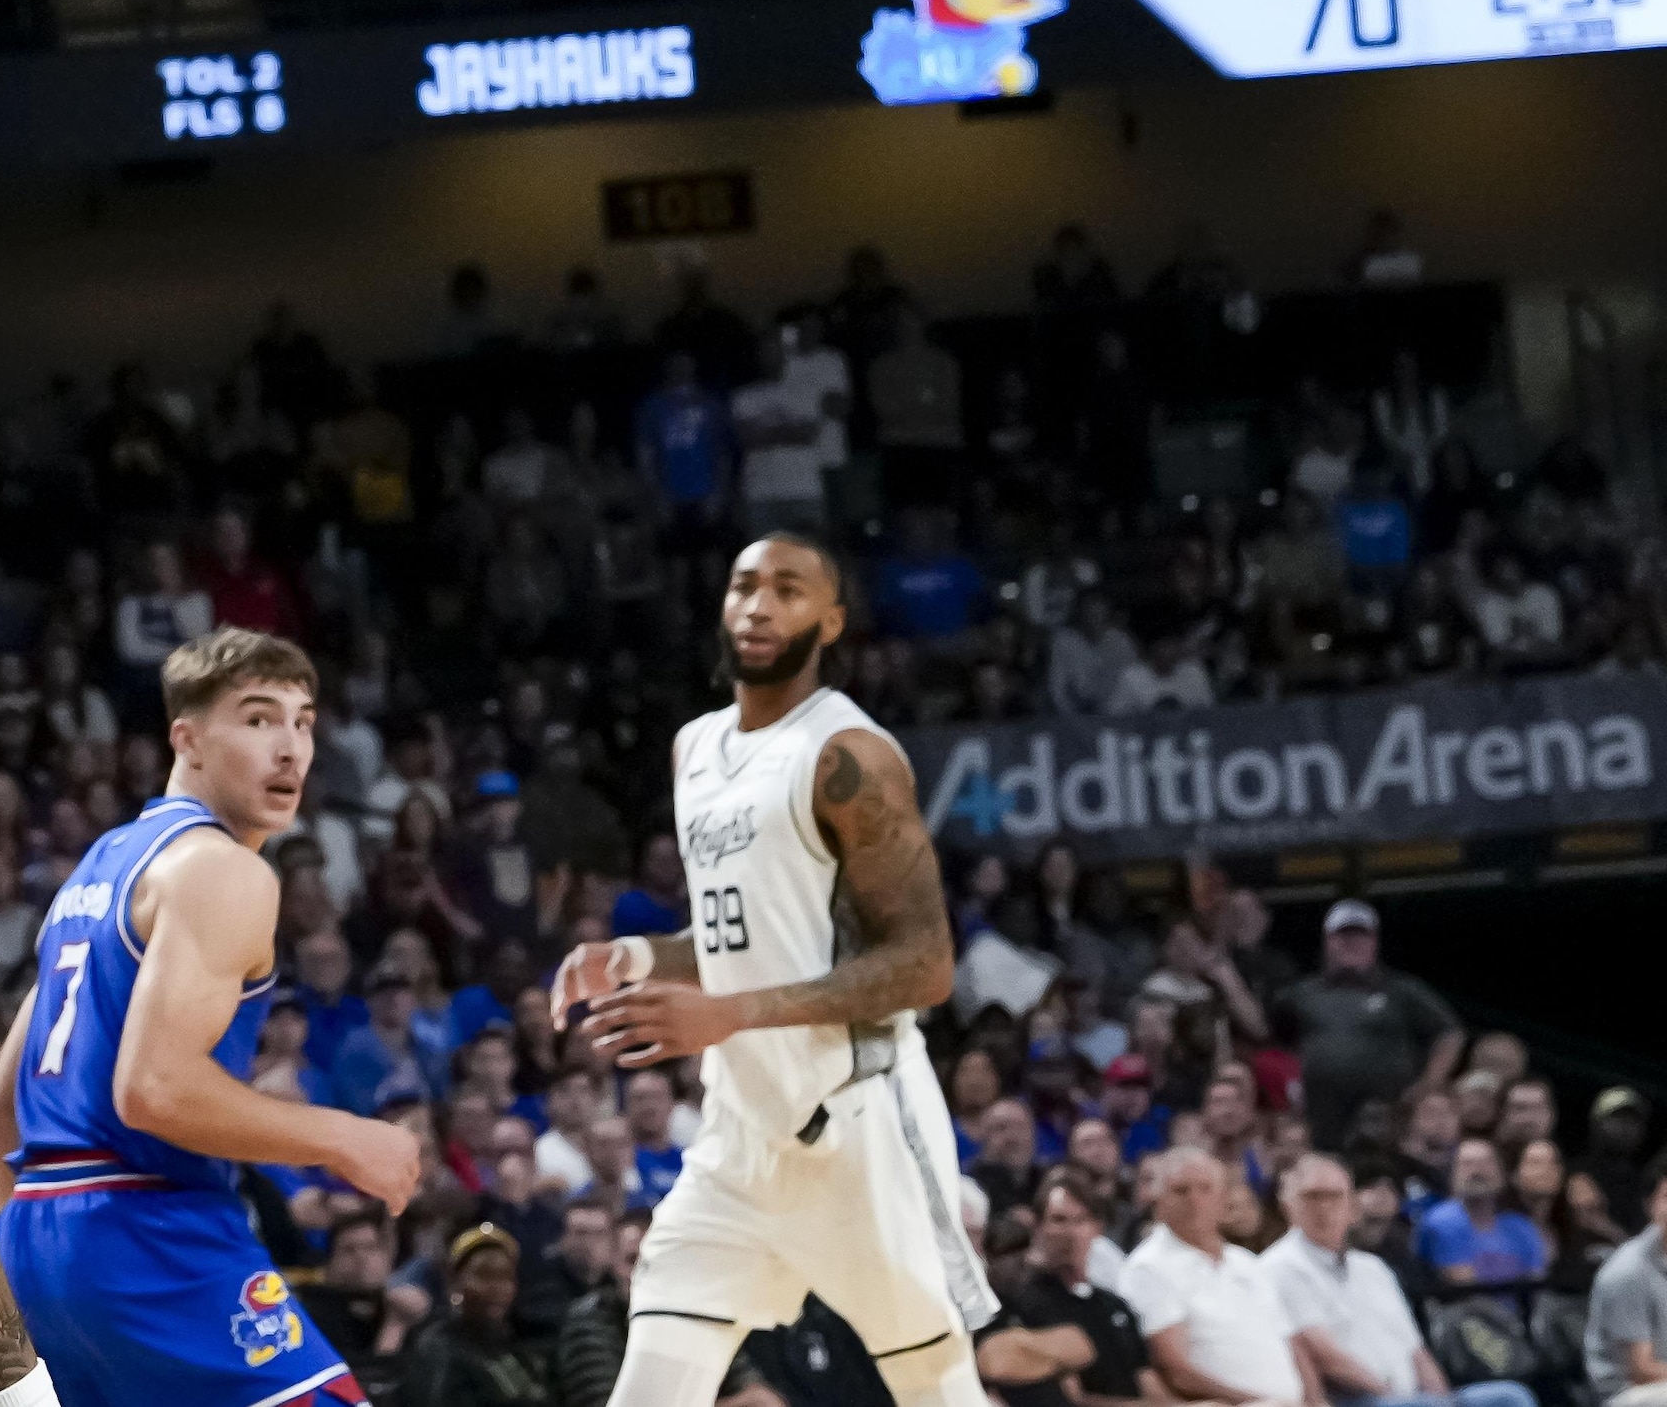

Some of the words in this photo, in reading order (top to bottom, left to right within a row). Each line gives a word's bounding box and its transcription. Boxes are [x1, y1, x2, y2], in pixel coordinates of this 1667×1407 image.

[156, 57, 245, 96] TOL
[251, 51, 282, 91] 2
[417, 24, 695, 116] JAYHAWKS
[163, 97, 243, 139] FLS
[926, 729, 1347, 837] Addition
[1357, 703, 1653, 807] Arena
[703, 885, 750, 954] 99
[35, 939, 92, 1080] 7
